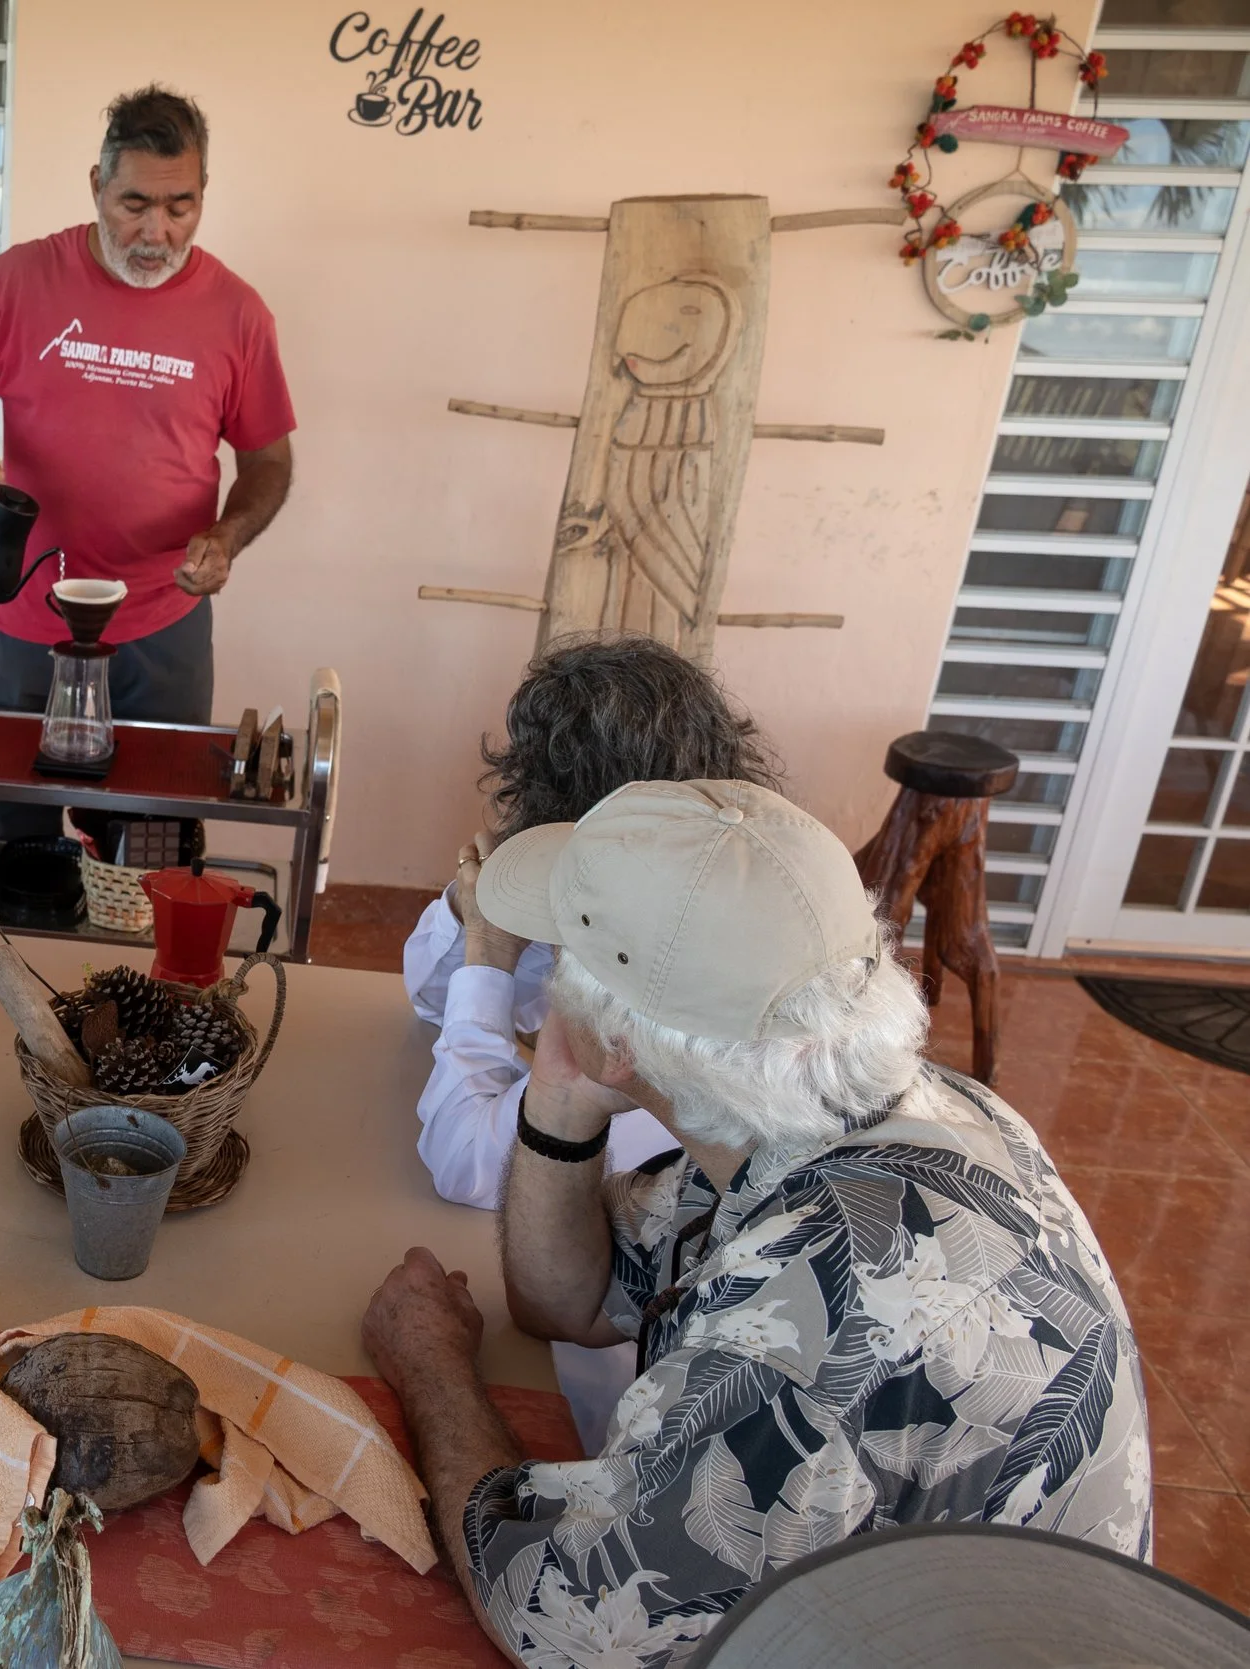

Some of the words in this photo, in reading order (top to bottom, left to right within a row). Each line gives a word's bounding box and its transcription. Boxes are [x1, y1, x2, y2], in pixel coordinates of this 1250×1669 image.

[329, 7, 481, 80] Coffee
[395, 75, 483, 136] Bar
[968, 109, 1018, 123] SANDRA
[1022, 111, 1063, 128] FARMS
[1066, 118, 1110, 140] COFFEE
[60, 339, 108, 363] SANDRA
[109, 347, 151, 370] FARMS
[152, 354, 195, 379] COFFEE
